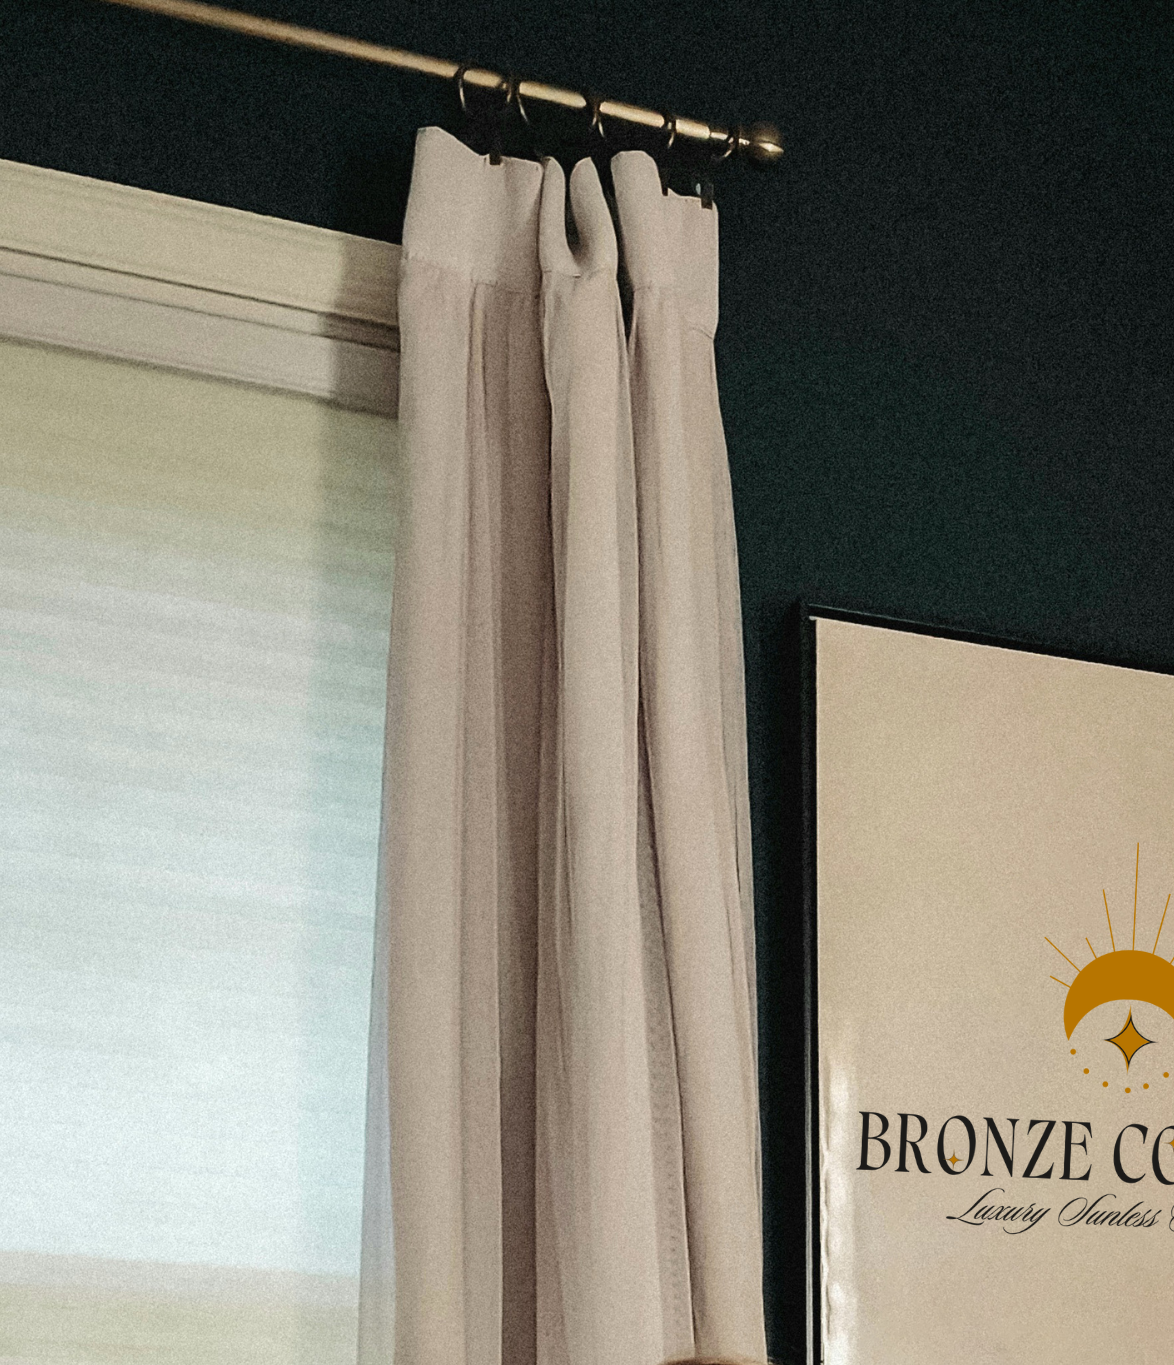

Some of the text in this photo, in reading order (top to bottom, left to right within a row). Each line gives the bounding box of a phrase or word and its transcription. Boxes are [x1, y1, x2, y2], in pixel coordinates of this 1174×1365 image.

[857, 1111, 1094, 1181] BRONZE
[946, 1188, 1051, 1235] Luxury
[1057, 1193, 1159, 1229] Sunless
